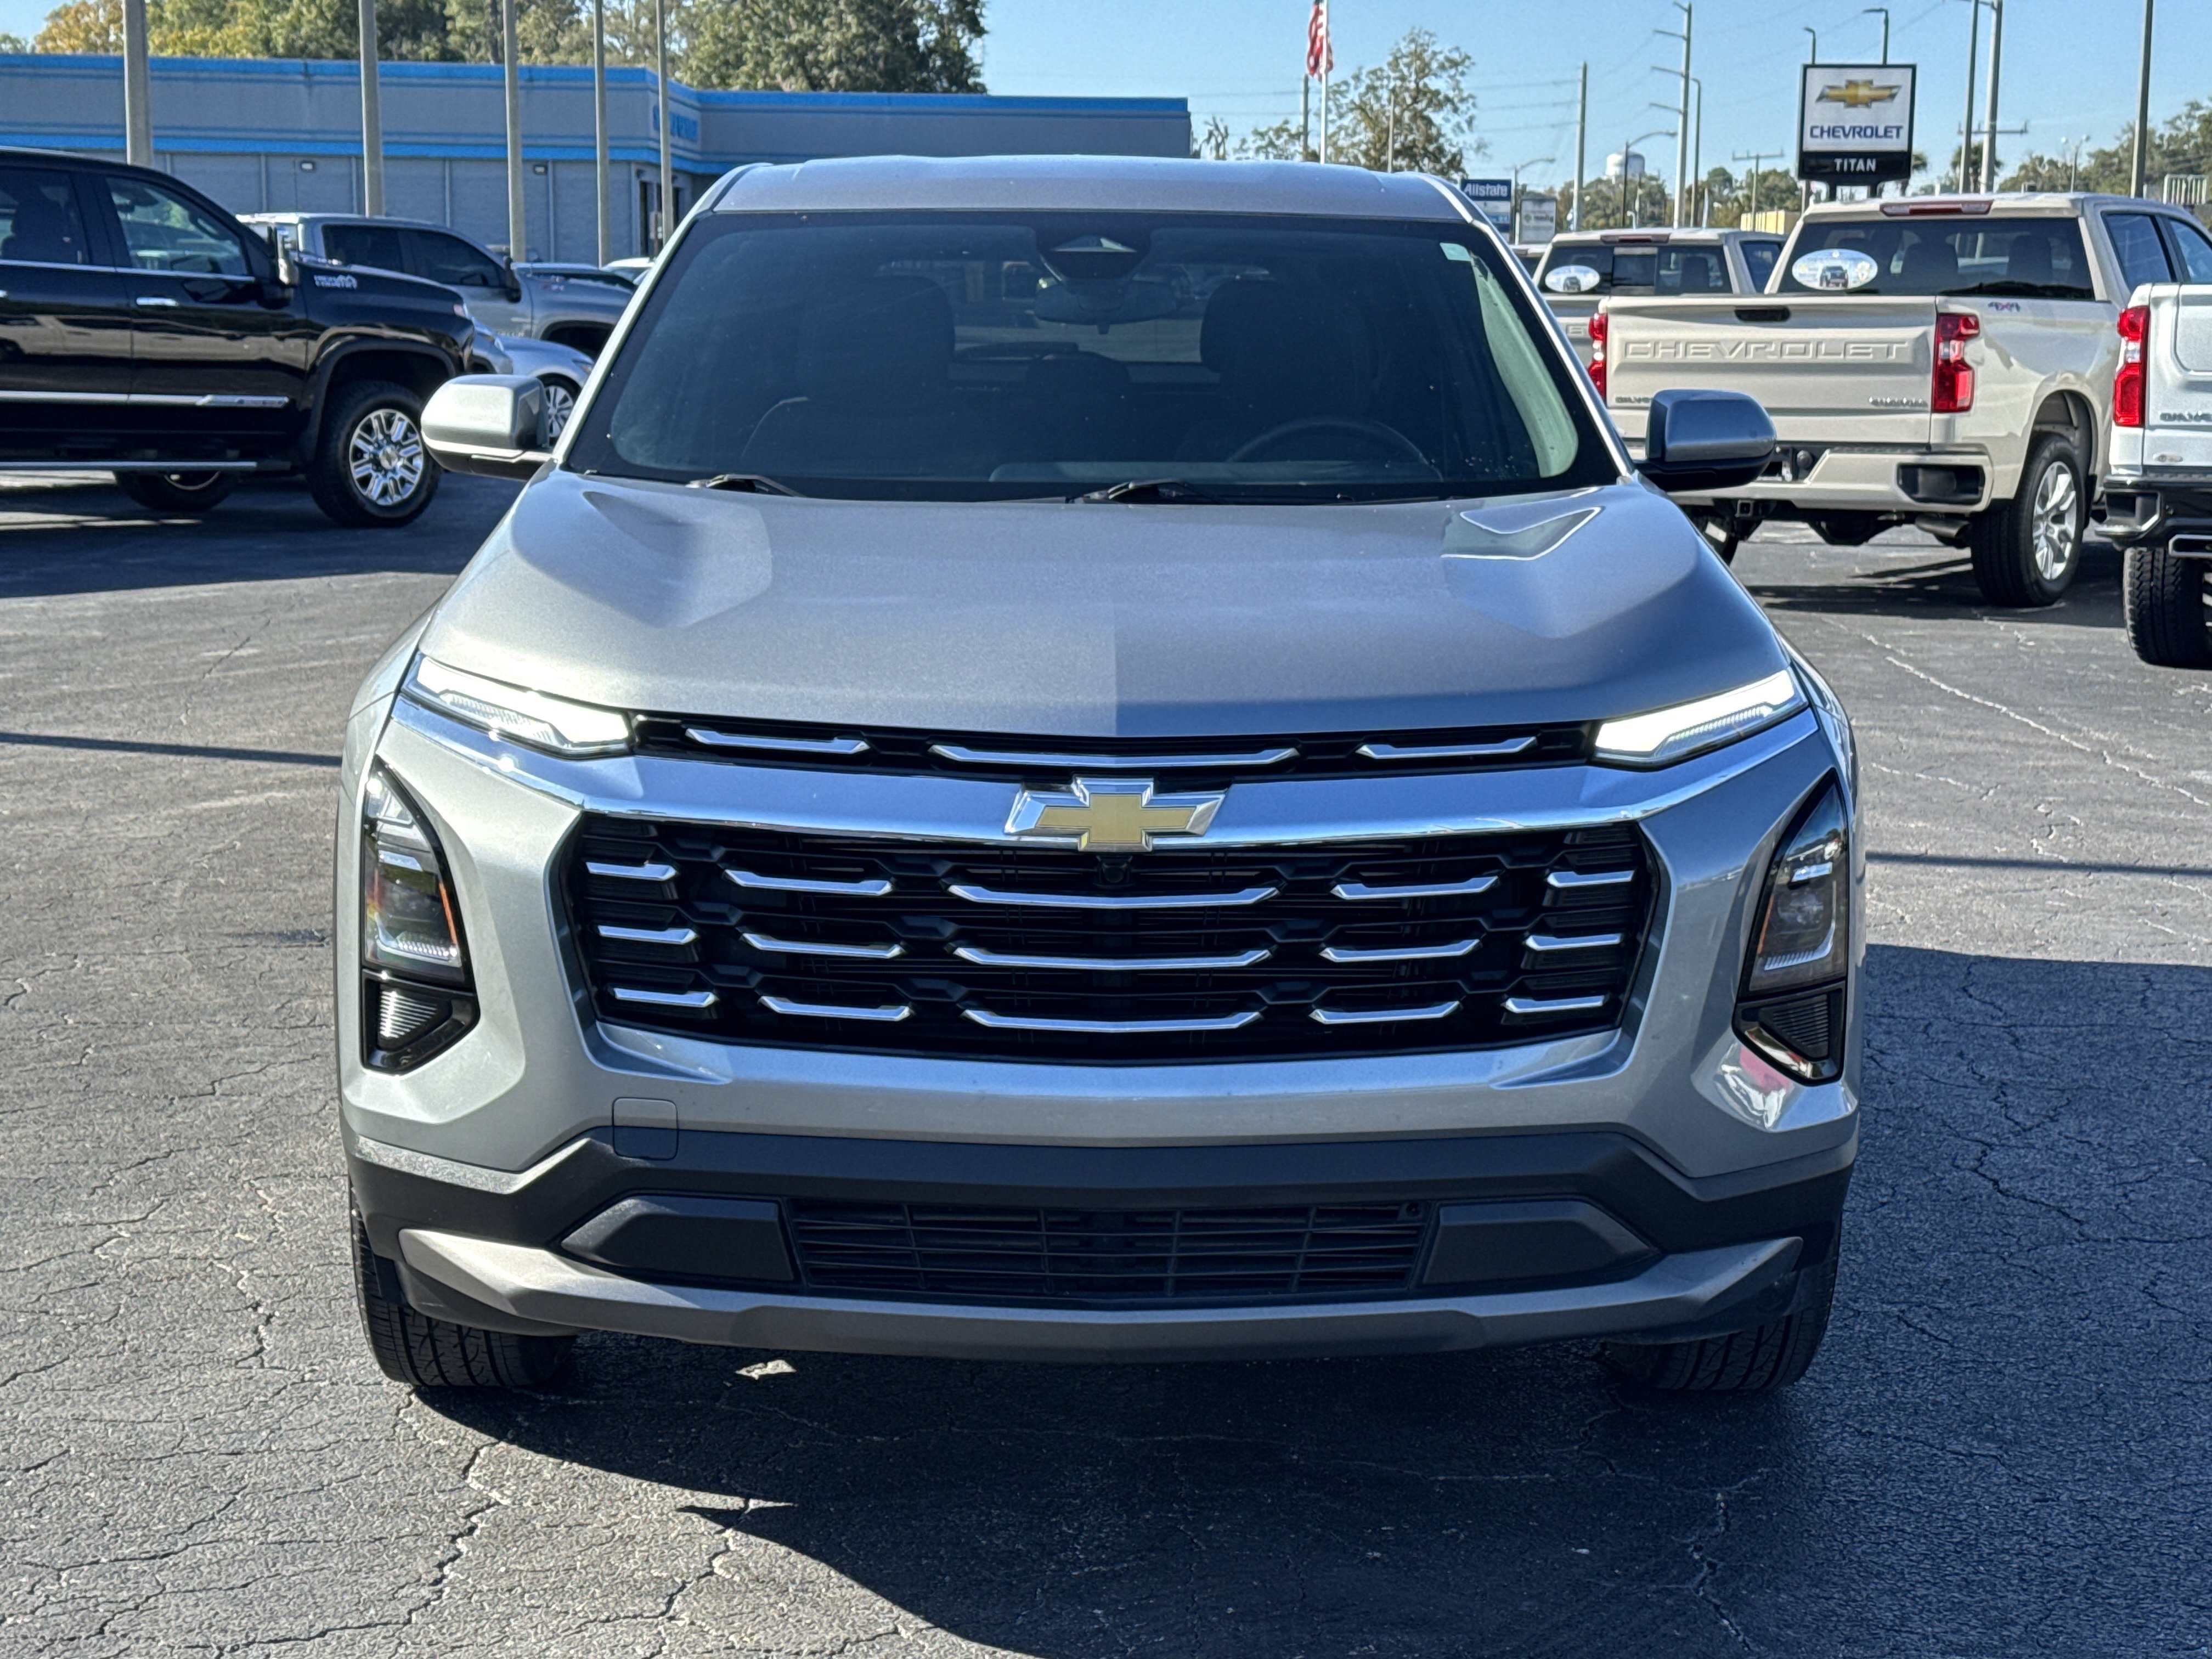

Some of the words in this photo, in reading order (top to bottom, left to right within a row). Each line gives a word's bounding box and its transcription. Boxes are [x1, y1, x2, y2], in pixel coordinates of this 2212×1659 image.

[1809, 125, 1903, 139] CHEVROLET
[1834, 158, 1876, 172] TITAN
[1463, 183, 1508, 197] Allstate
[1624, 340, 1909, 360] CHEVROLET
